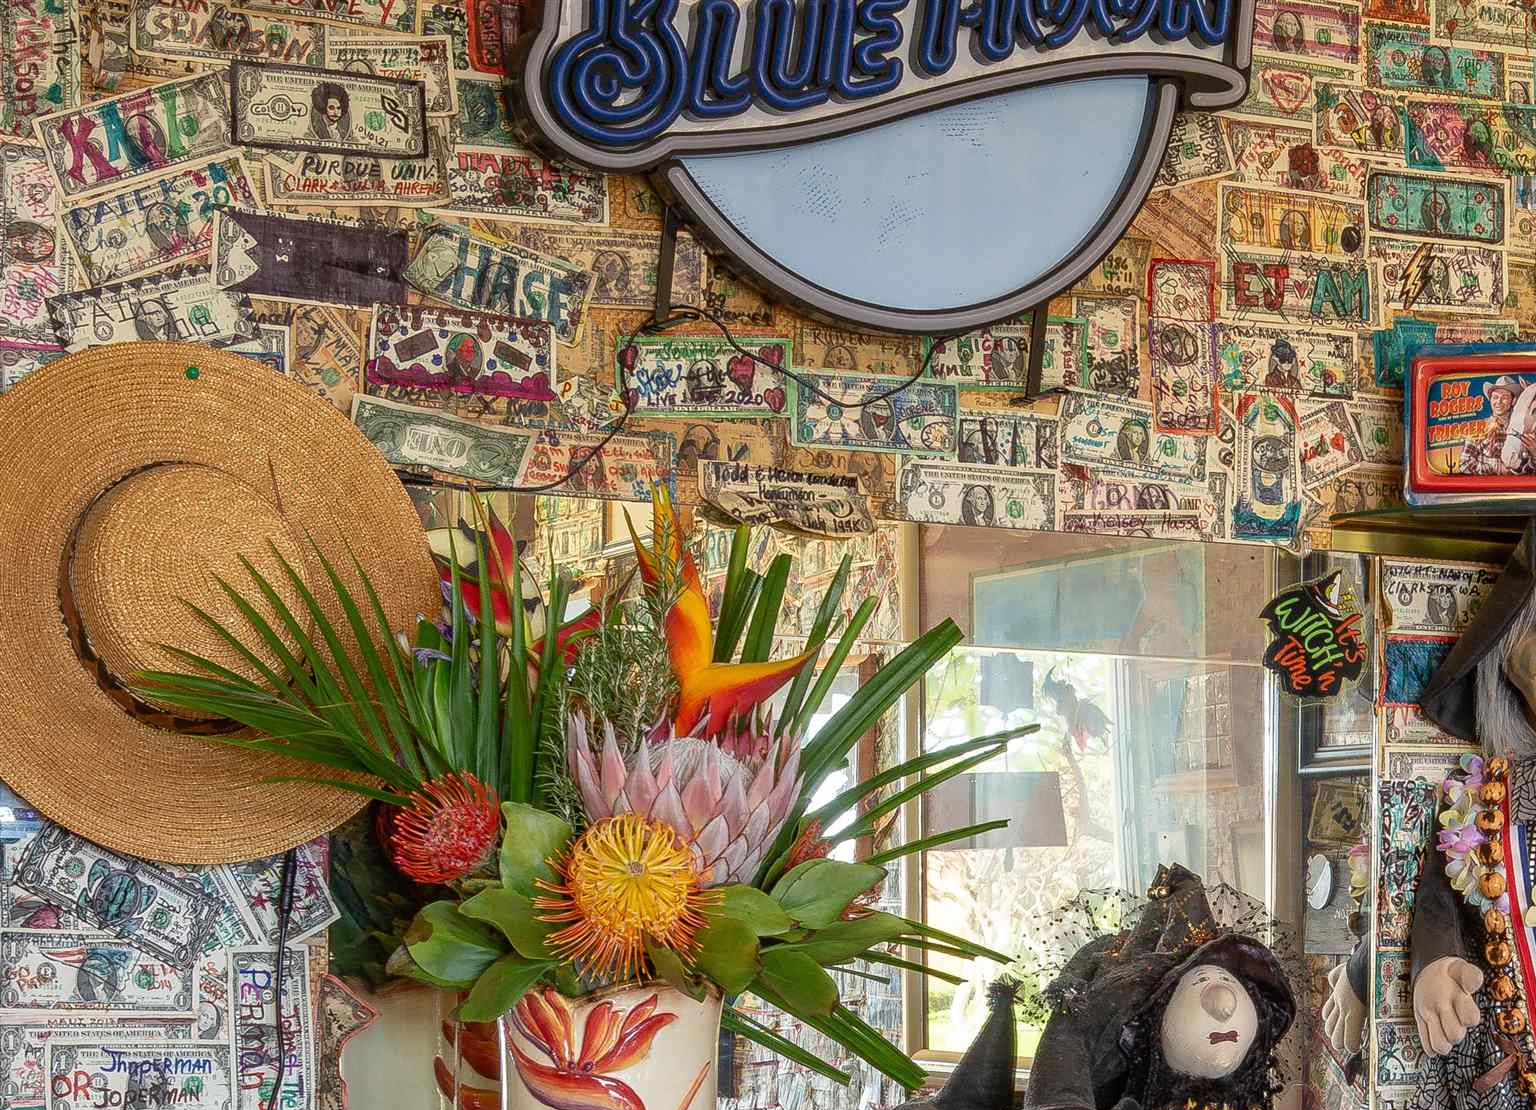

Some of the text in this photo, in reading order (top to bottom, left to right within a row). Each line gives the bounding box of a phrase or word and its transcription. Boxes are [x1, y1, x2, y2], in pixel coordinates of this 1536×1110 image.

[300, 155, 382, 177] PURDUE
[1440, 381, 1472, 399] ROY
[1429, 395, 1484, 418] ROGERS
[1428, 417, 1495, 442] TRIGGER
[1334, 613, 1369, 664] It's
[51, 1070, 92, 1101] OR
